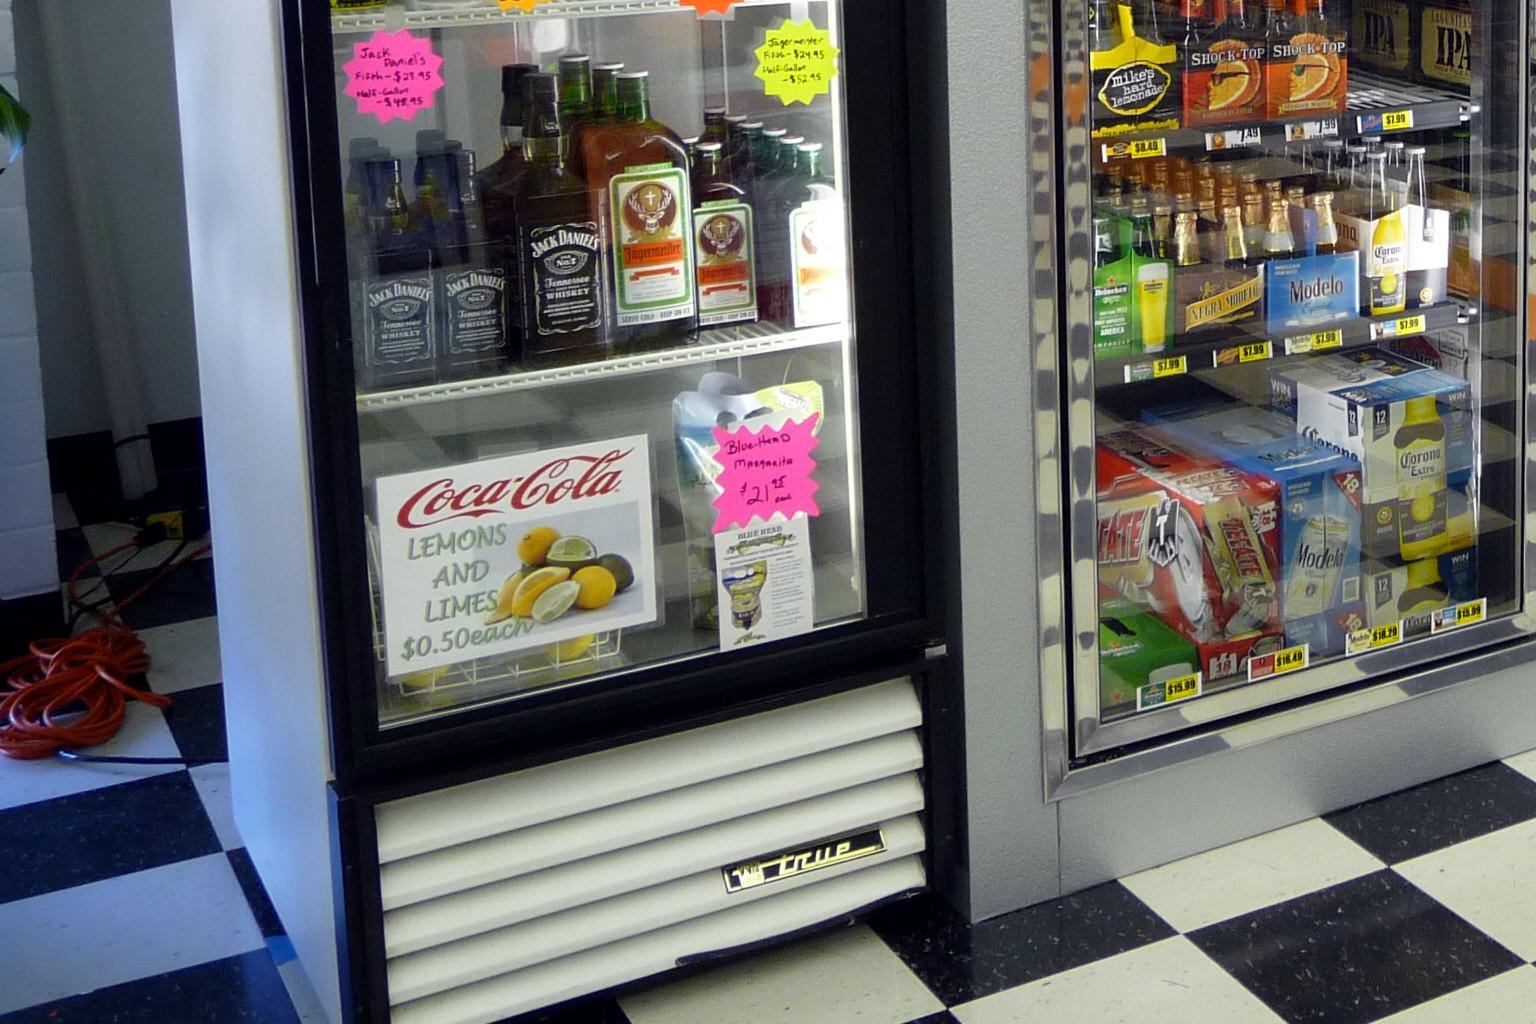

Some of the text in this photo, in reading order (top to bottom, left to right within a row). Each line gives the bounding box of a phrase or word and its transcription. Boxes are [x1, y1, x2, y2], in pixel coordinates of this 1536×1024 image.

[1364, 10, 1397, 63] IPA
[360, 47, 391, 60] Jack
[1191, 46, 1266, 67] SHOCK TOP
[1272, 40, 1346, 59] SHOCK TOP
[1436, 25, 1472, 72] IPA
[1111, 68, 1156, 89] mike's
[1122, 79, 1154, 97] hard
[1111, 85, 1164, 109] lemonade
[1386, 113, 1406, 125] $7.99
[1135, 141, 1158, 154] $8.49
[531, 229, 601, 259] JACK DANIEL'S
[446, 273, 507, 297] JACK DANIEL'S
[544, 276, 591, 288] Tennessee
[1289, 276, 1344, 305] Modelo
[368, 283, 432, 308] JACK DANIEL'S
[545, 288, 591, 301] WHISKEY
[458, 319, 498, 330] WHISKEY
[1399, 319, 1419, 330] $7.99
[381, 330, 422, 341] WHISKEY
[1315, 333, 1336, 345] $7.99
[1242, 345, 1265, 357] $7.99
[1158, 359, 1180, 371] $7.99
[1270, 380, 1292, 397] WIN
[1448, 391, 1466, 402] WIN
[1375, 410, 1387, 425] 12
[1301, 425, 1359, 463] Corona
[1400, 447, 1441, 470] Corona
[1411, 464, 1435, 477] Extra
[397, 446, 635, 529] Coca-Cola
[1345, 473, 1361, 493] 18
[407, 522, 508, 561] LEMONS
[1451, 552, 1471, 564] WIN
[432, 559, 491, 589] AND
[1376, 577, 1389, 592] 12
[425, 591, 499, 624] LIMES
[1456, 606, 1482, 620] $15.99
[1372, 626, 1399, 642] $18.29
[1275, 650, 1304, 668] $16.49
[1167, 680, 1196, 696] $15.99
